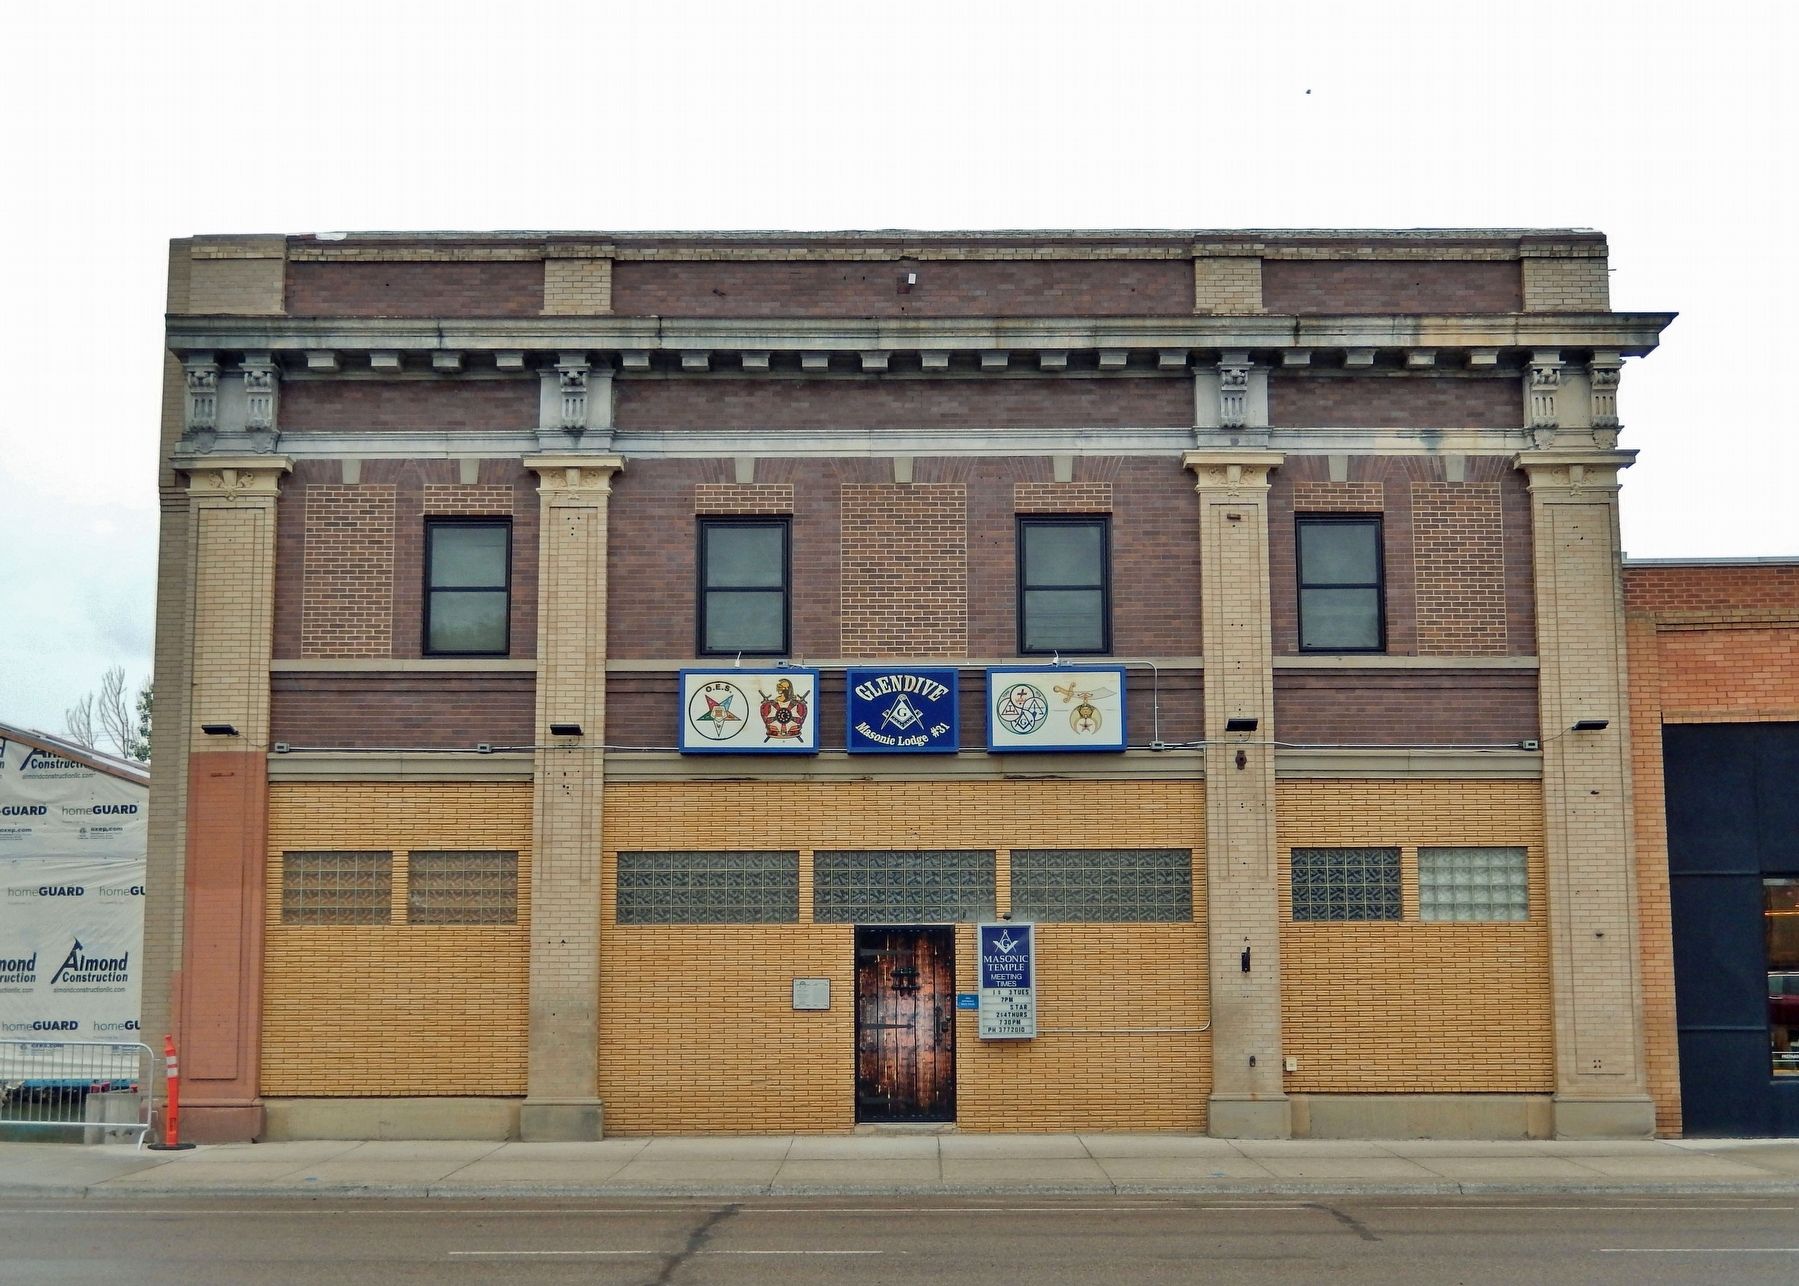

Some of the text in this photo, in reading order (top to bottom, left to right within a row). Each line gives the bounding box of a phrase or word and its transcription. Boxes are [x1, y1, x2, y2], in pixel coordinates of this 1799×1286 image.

[705, 683, 732, 693] O.E.S.
[855, 674, 949, 702] GLENDIVE
[896, 707, 907, 718] G
[855, 721, 950, 747] Masonic Lodge #31
[0, 805, 47, 816] GUARD
[62, 804, 138, 816] homeGUARD
[8, 886, 84, 897] homeGUARD
[99, 885, 146, 896] homeGU
[51, 937, 128, 984] Almond
[984, 955, 1028, 963] MASONIC
[988, 963, 1025, 971] TEMPLE
[62, 972, 128, 982] Construction
[2, 1020, 79, 1031] homeGUARD
[93, 1020, 141, 1031] homeGU
